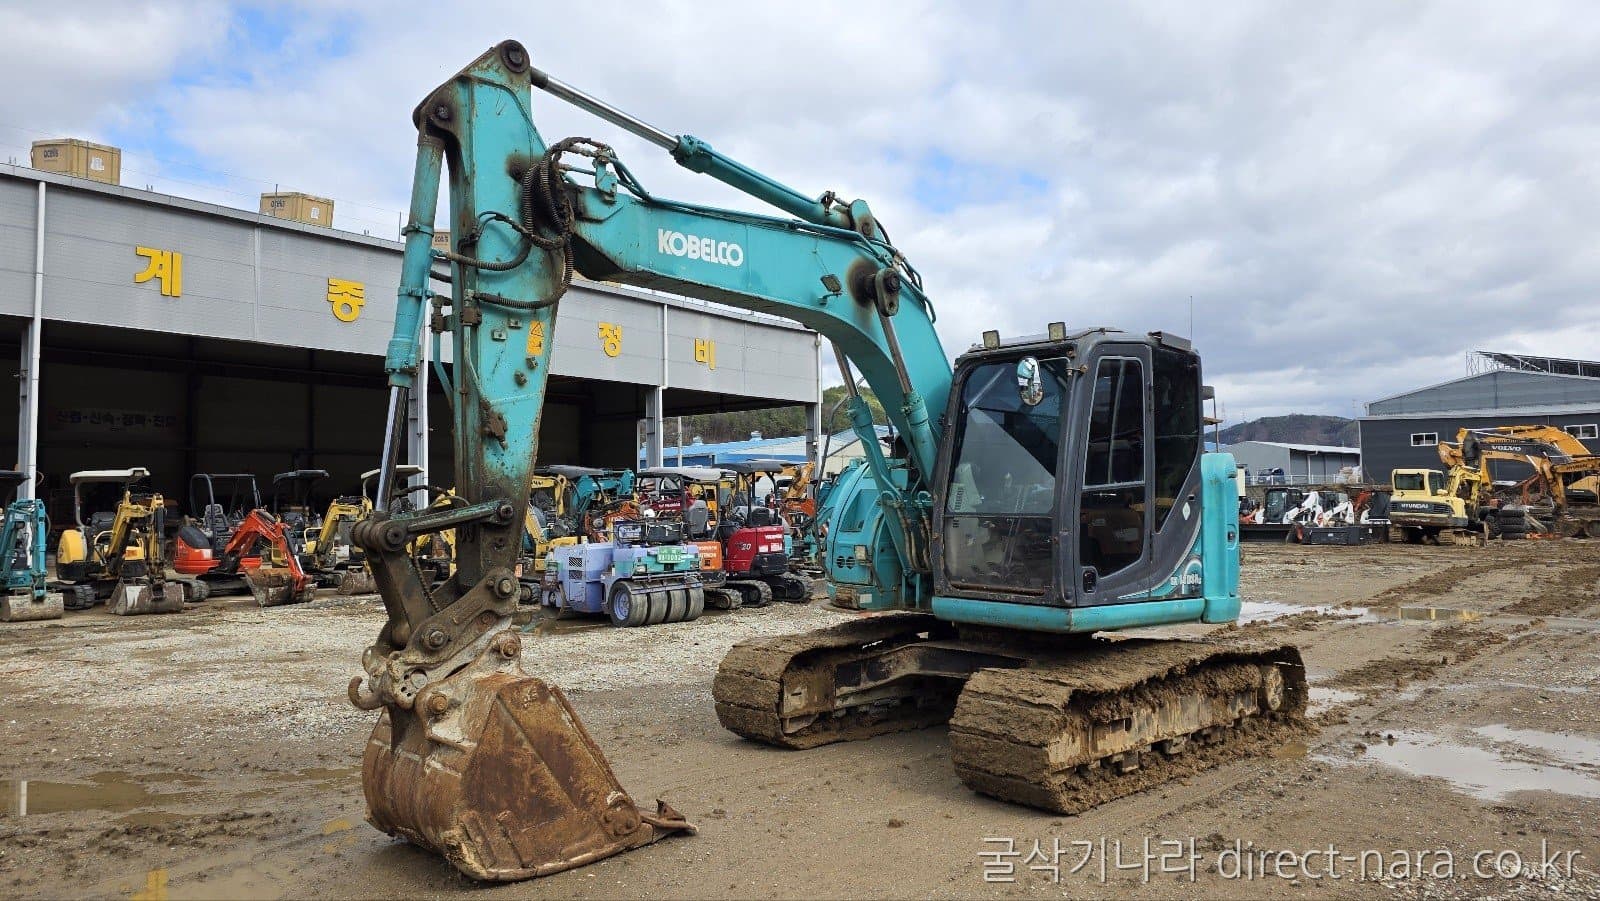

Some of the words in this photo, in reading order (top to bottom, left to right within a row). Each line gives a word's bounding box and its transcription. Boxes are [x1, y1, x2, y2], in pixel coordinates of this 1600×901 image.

[657, 227, 744, 267] KOBELCO
[135, 246, 183, 298] 계
[327, 277, 366, 323] 종
[597, 321, 622, 358] 정
[694, 337, 716, 370] 비
